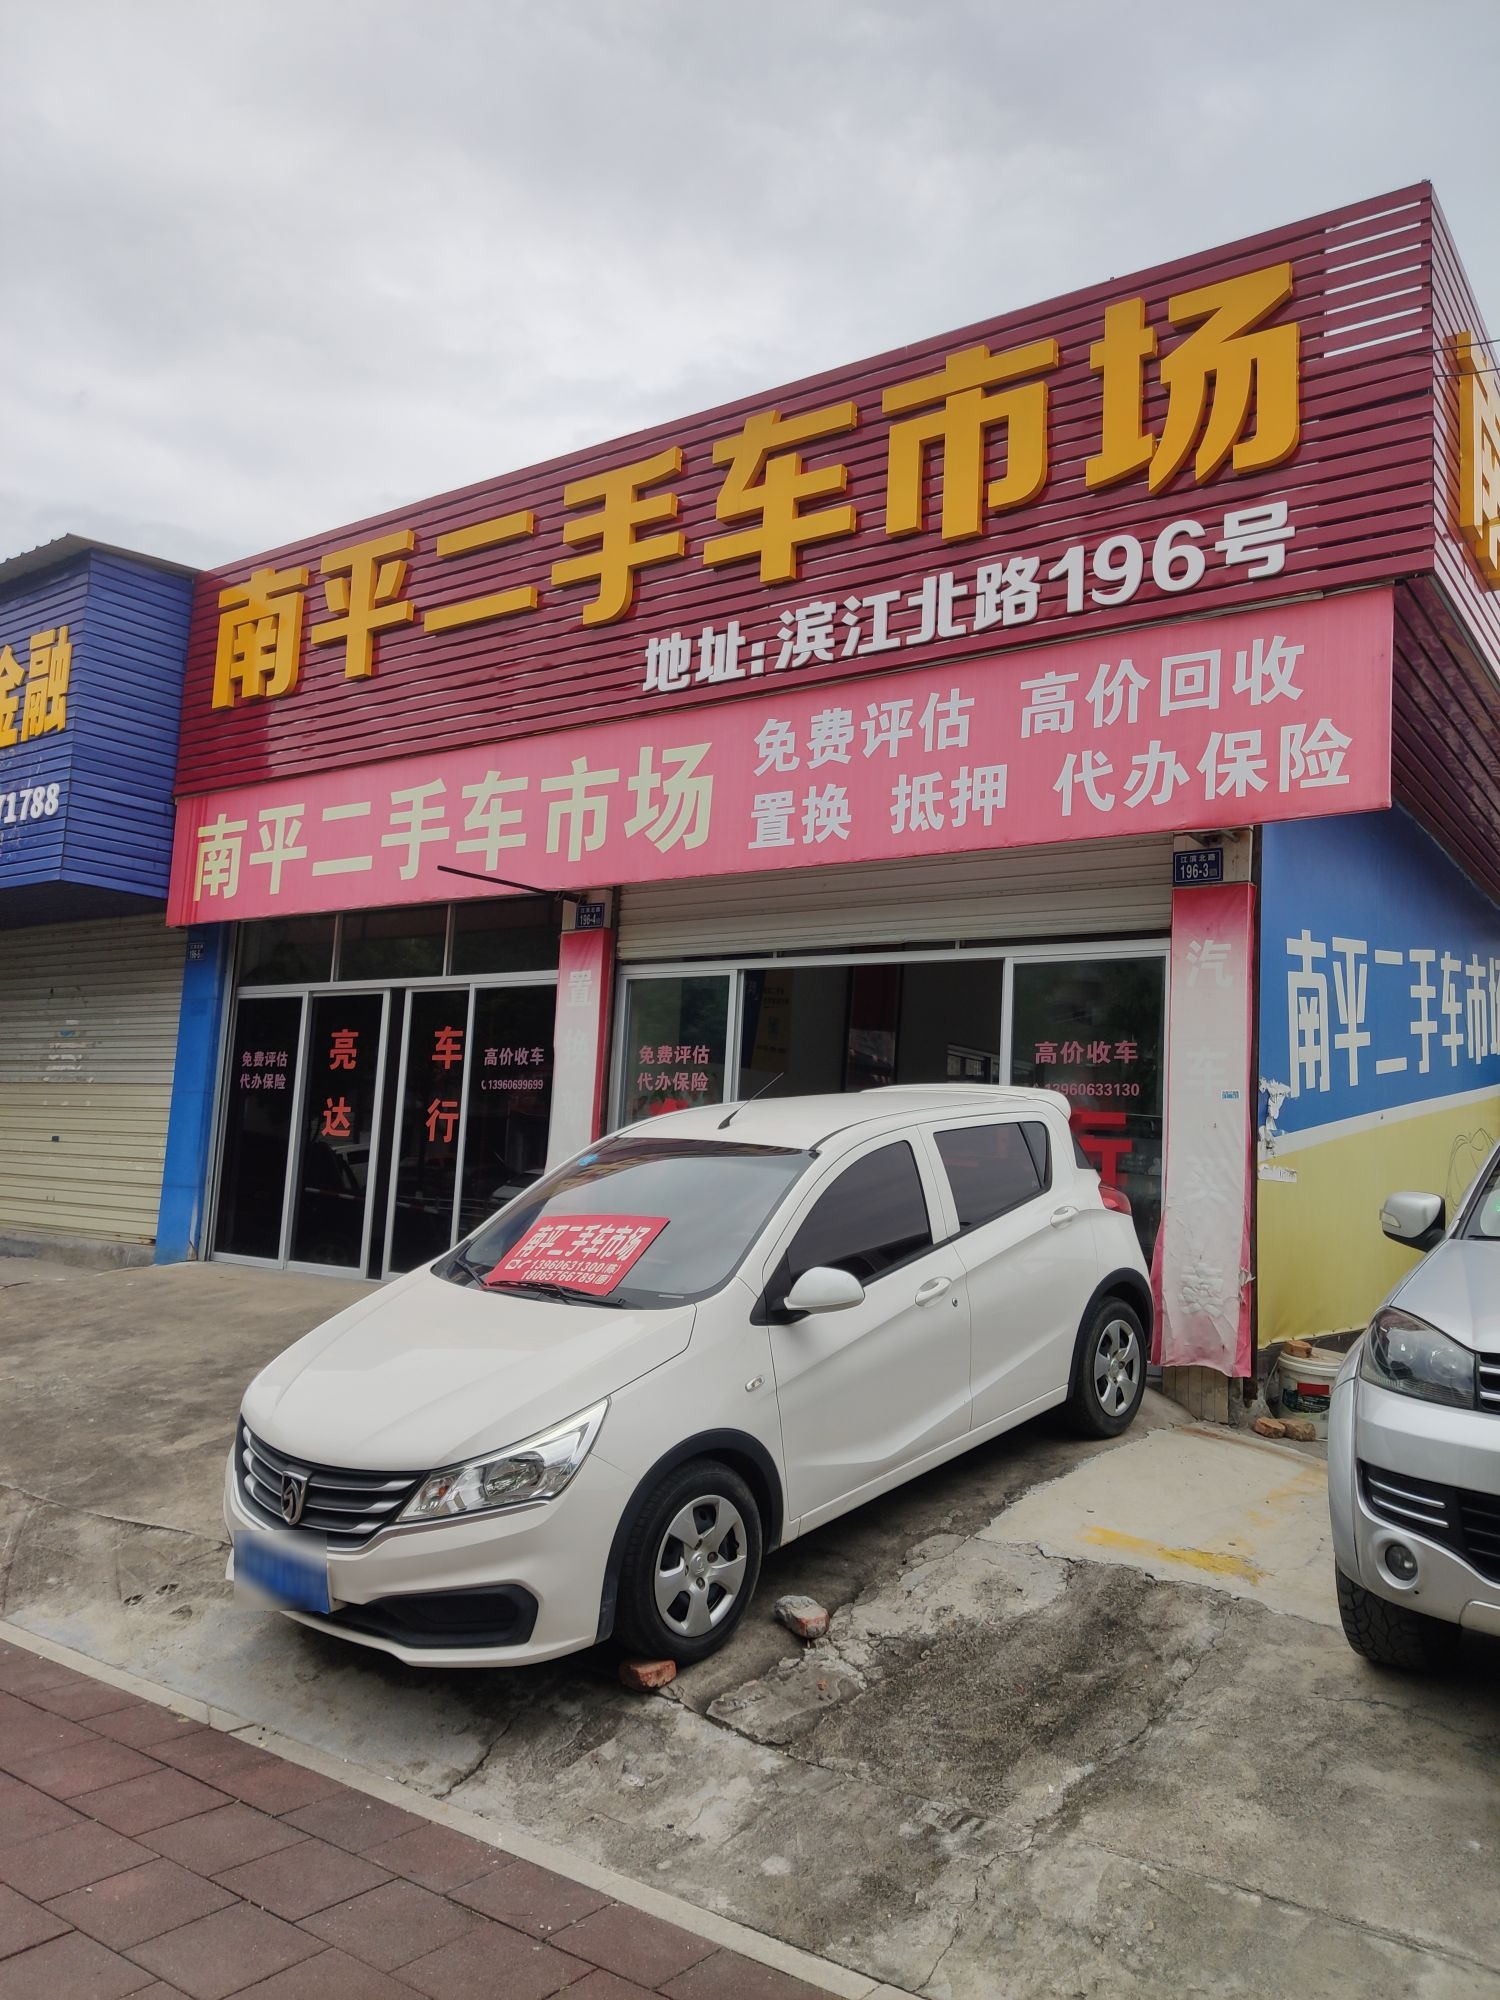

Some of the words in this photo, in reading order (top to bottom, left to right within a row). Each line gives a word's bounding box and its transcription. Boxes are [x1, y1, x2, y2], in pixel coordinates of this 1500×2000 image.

[211, 261, 1301, 711] 南平二手车市场
[753, 688, 976, 777] 免费评估
[1020, 635, 1305, 739] 高价回收
[747, 783, 852, 851] 置换
[890, 764, 1008, 834] 抵押
[1053, 717, 1353, 817] 代办保险
[194, 742, 713, 902] 南平二手车市场
[242, 1051, 288, 1067] 免费评估
[484, 1047, 545, 1066] 高价收车
[639, 1045, 710, 1064] 免费评估
[1034, 1040, 1138, 1064] 高价收车
[240, 1073, 286, 1089] 代办保险
[321, 1029, 359, 1137] 亮达
[425, 1025, 464, 1143] 车行
[637, 1072, 709, 1091] 代办保险
[514, 1224, 651, 1261] 南平二手车市场
